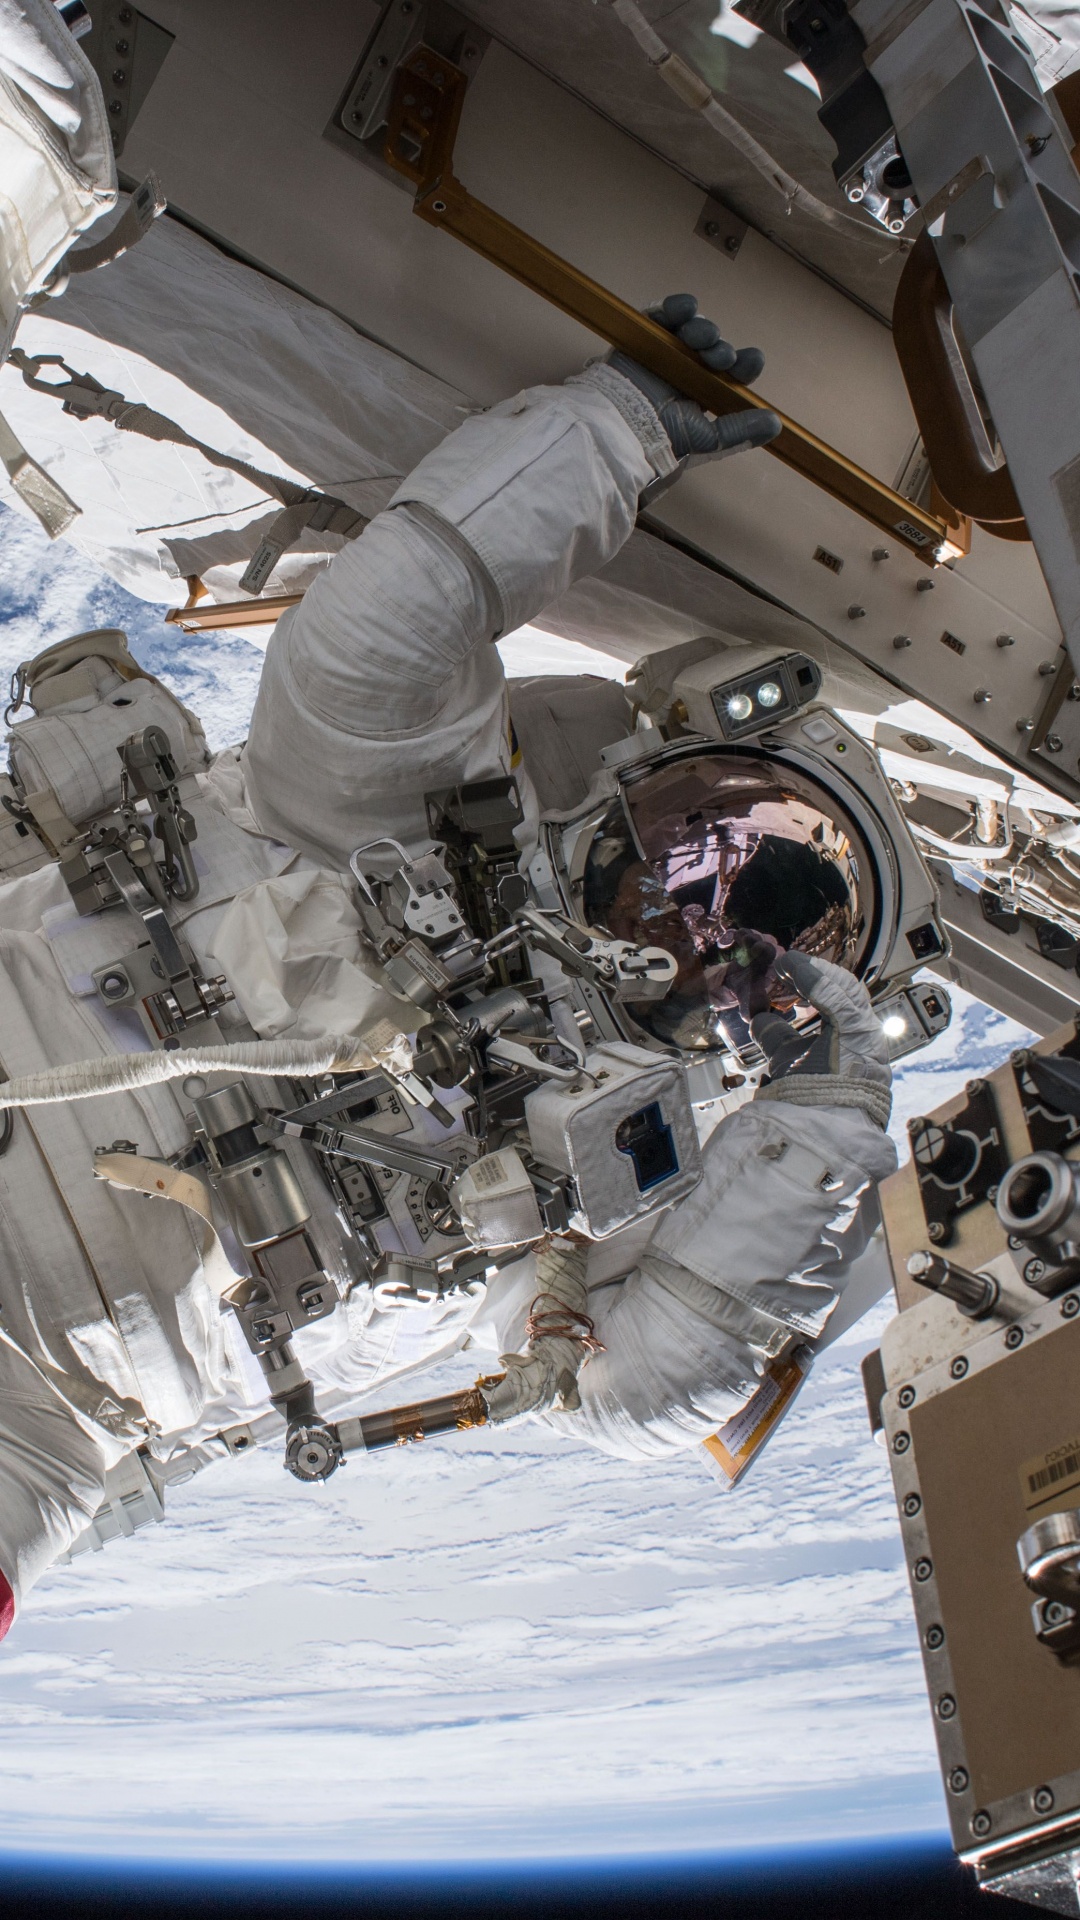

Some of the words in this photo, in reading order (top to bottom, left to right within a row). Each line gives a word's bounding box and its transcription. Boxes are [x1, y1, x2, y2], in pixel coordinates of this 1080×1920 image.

[899, 522, 926, 541] 3684
[252, 568, 261, 581] S/N
[258, 550, 271, 568] 4025
[817, 550, 838, 570] A51
[943, 634, 962, 653] A51
